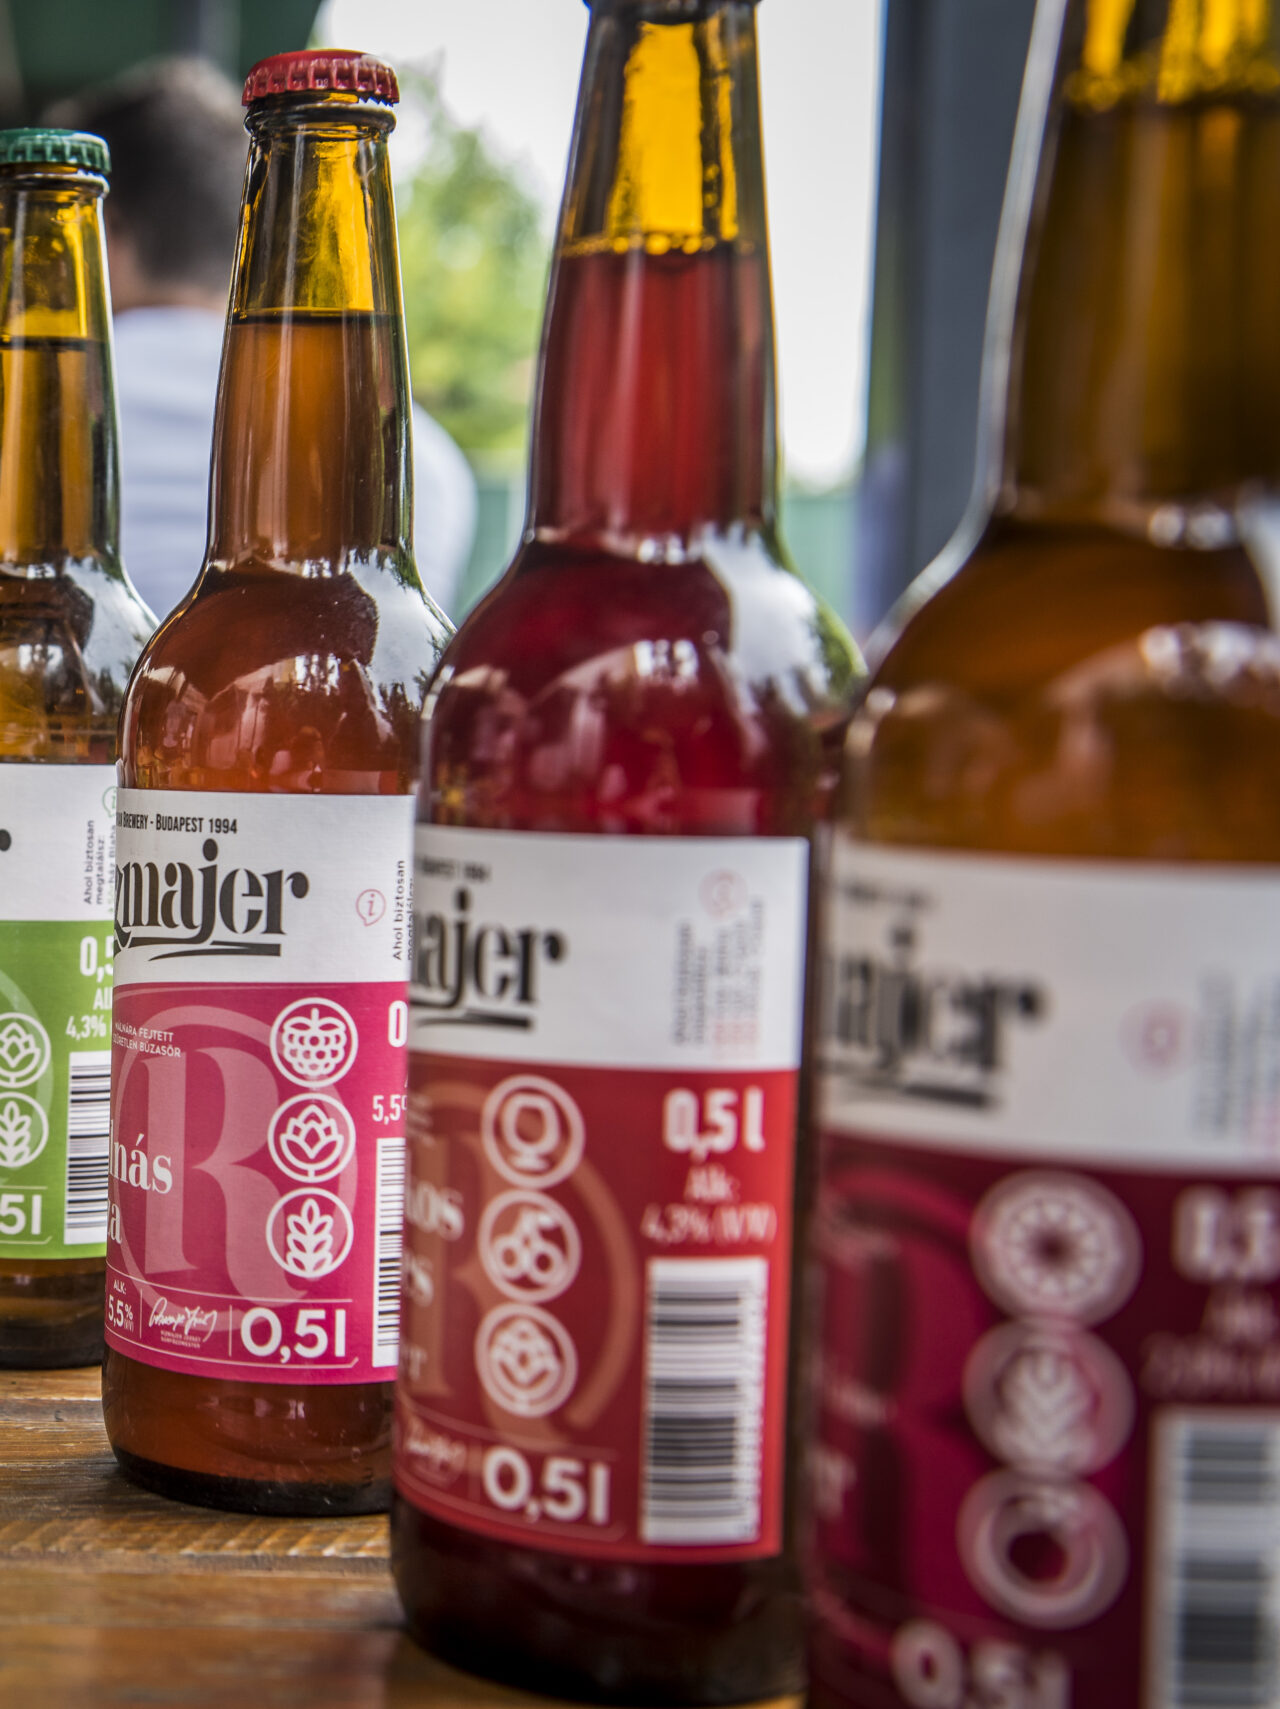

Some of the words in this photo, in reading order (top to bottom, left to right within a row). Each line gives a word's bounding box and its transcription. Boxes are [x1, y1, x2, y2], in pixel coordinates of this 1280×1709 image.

[123, 811, 149, 830] BREWERY
[156, 814, 203, 833] BUDAPEST
[209, 818, 237, 834] 1994
[84, 819, 94, 872] biztosan
[84, 876, 93, 905] Ahol
[394, 861, 405, 922] biztosan
[393, 928, 403, 960] Ahol
[416, 886, 570, 1010] ajer
[65, 1015, 107, 1041] 4,3%
[138, 1027, 174, 1042] FEJTETT
[109, 1119, 173, 1194] lnás
[113, 1280, 127, 1295] ALK:
[241, 1307, 346, 1363] 0,5l
[483, 1446, 610, 1525] 0,5l
